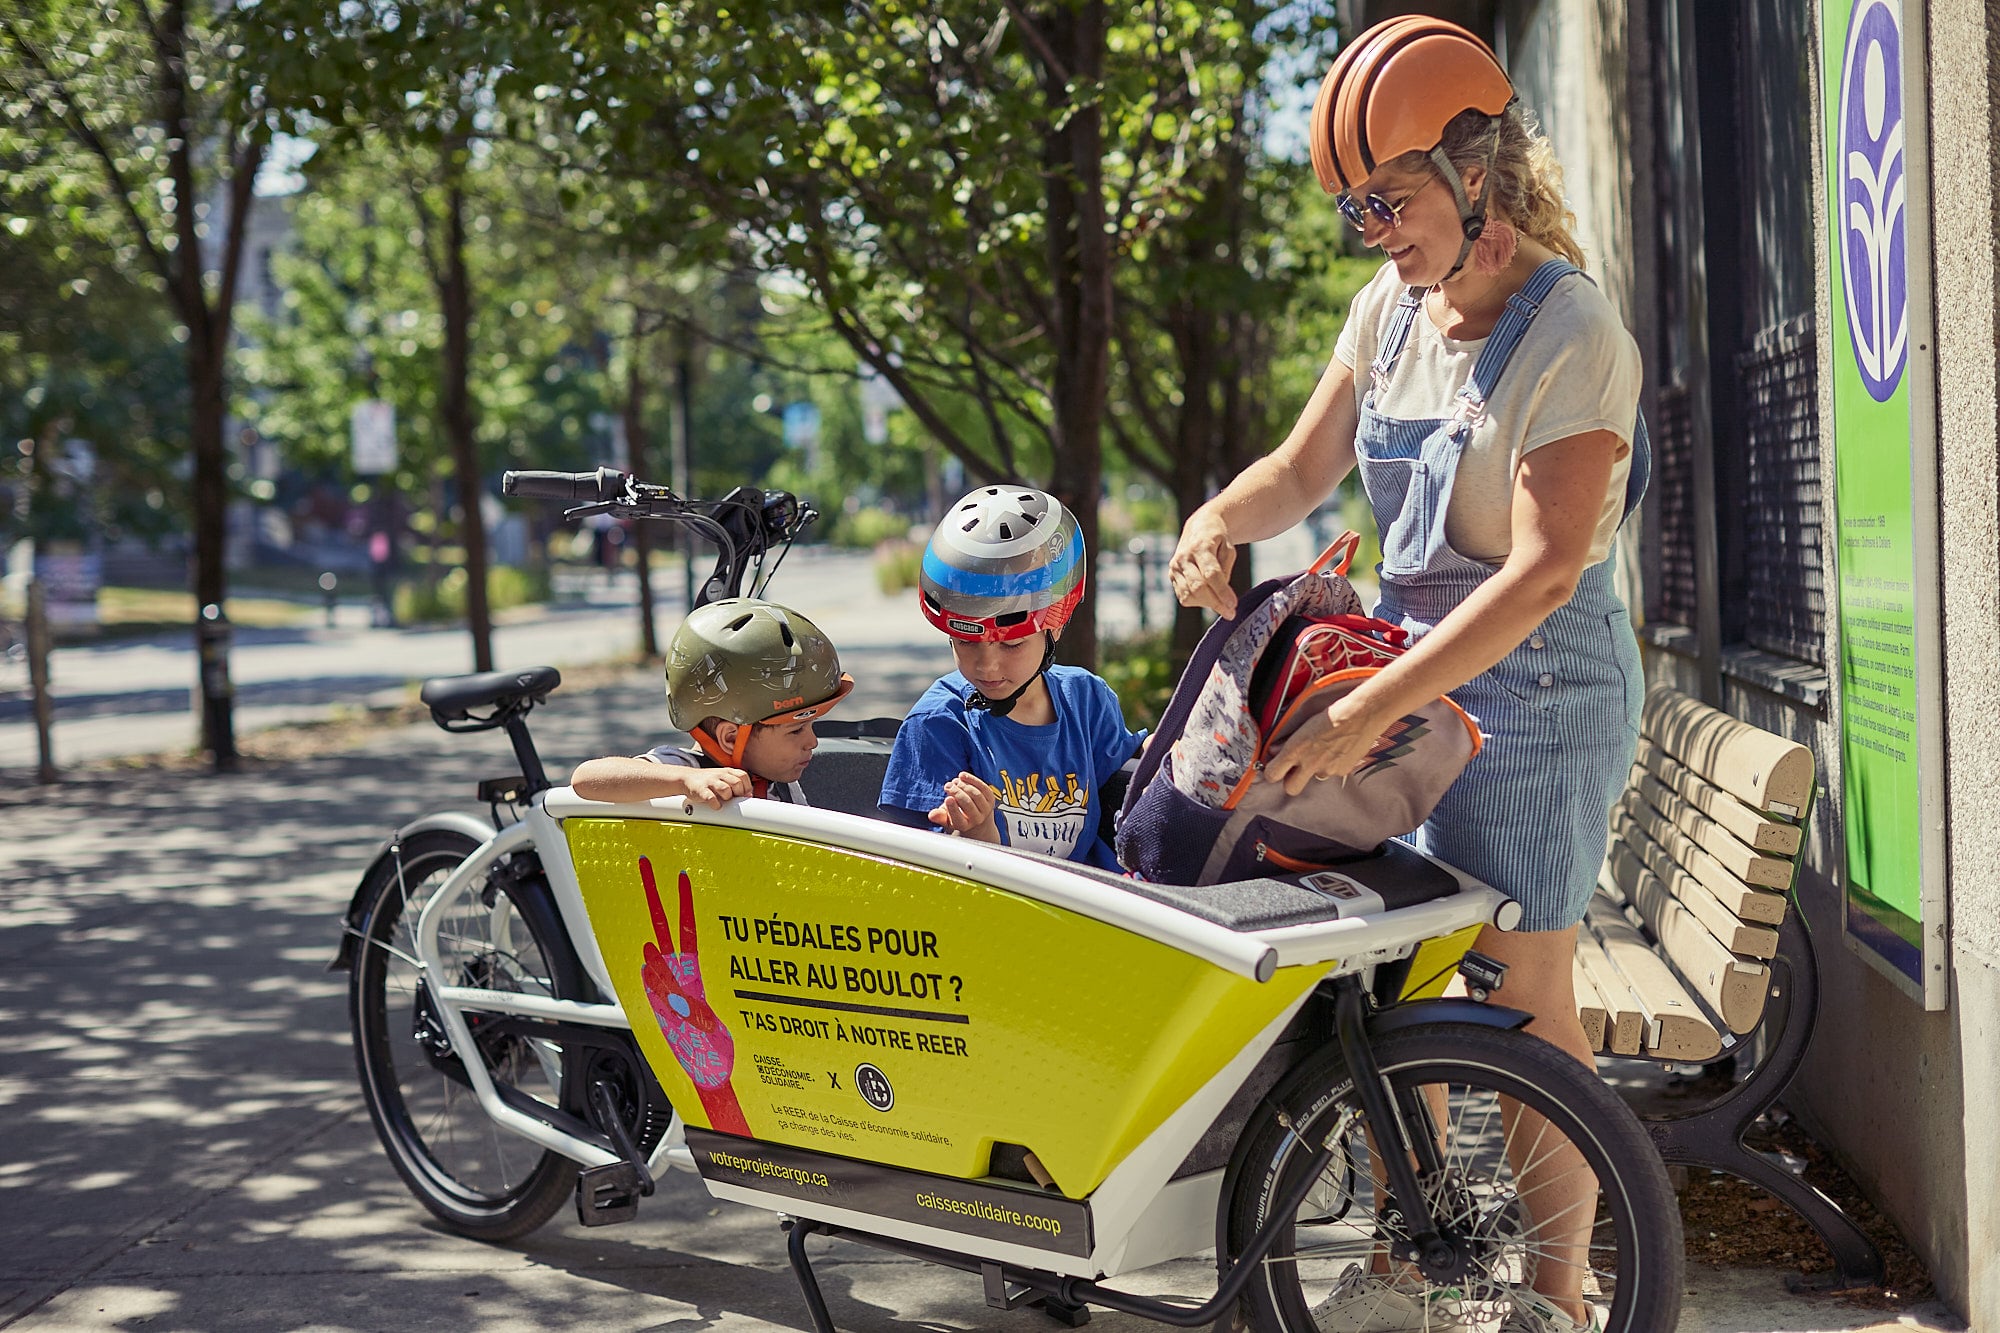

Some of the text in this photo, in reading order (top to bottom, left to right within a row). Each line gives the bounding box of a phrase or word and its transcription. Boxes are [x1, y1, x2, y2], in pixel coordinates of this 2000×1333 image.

[773, 695, 804, 711] bern
[719, 912, 939, 958] TU PÉDALES POUR
[730, 955, 964, 1002] ALLER AU BOULOT ?
[740, 1010, 969, 1057] T'AS DROIT À NOTRE REER
[771, 1103, 953, 1147] Le REER de la Caisse d'économie solidaire,
[778, 1119, 857, 1142] ça change des vies.
[1295, 1112, 1310, 1129] BIG
[1311, 1094, 1328, 1112] BEN
[709, 1150, 829, 1187] votreprojetcargo.ca
[916, 1191, 1062, 1236] caissesolidaire.coop
